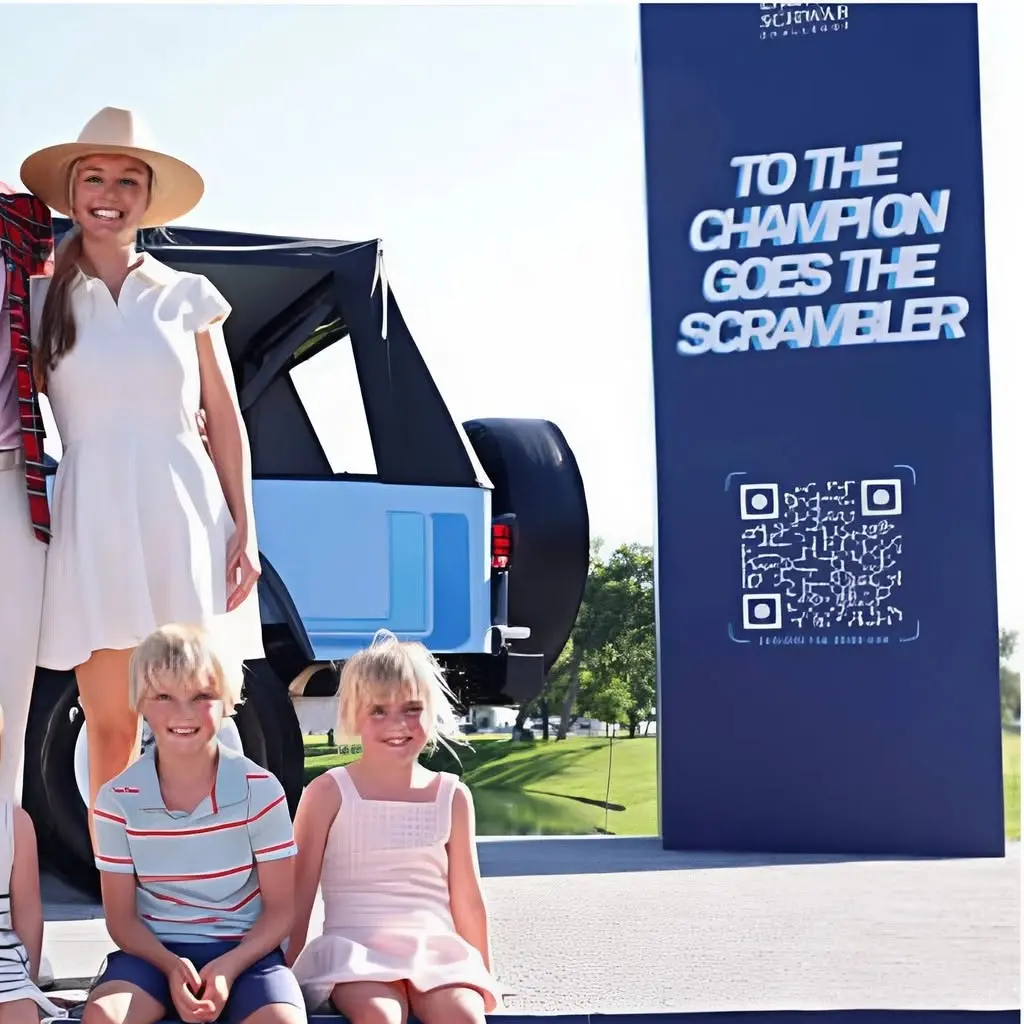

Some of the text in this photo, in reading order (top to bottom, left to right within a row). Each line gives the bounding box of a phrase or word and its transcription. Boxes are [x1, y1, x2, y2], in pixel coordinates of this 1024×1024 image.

[730, 141, 903, 198] TO THE
[688, 189, 951, 252] CHAMPION
[702, 244, 941, 302] GOES THE
[676, 296, 970, 355] SCRAMBLER
